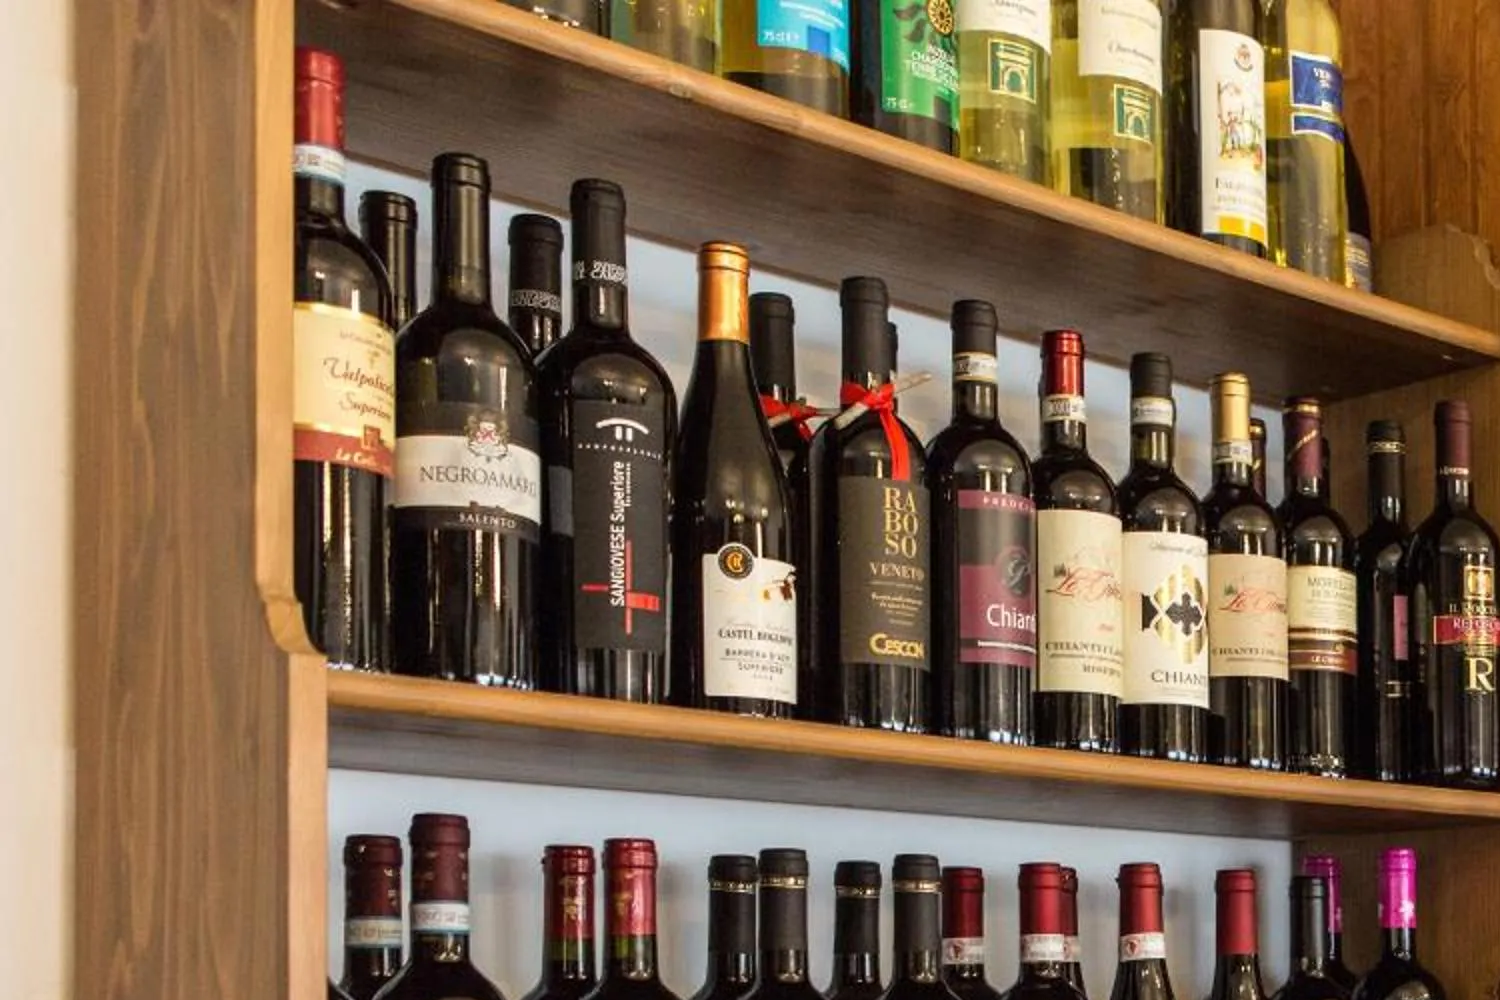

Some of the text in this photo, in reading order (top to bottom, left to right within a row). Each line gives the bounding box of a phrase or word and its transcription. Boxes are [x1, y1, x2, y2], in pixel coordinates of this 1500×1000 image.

[419, 465, 537, 498] NEGROAMARO
[459, 513, 516, 529] SALENTO
[609, 461, 626, 607] SANGIOVESE Superiore
[869, 562, 925, 581] VENETO
[1464, 657, 1496, 692] R
